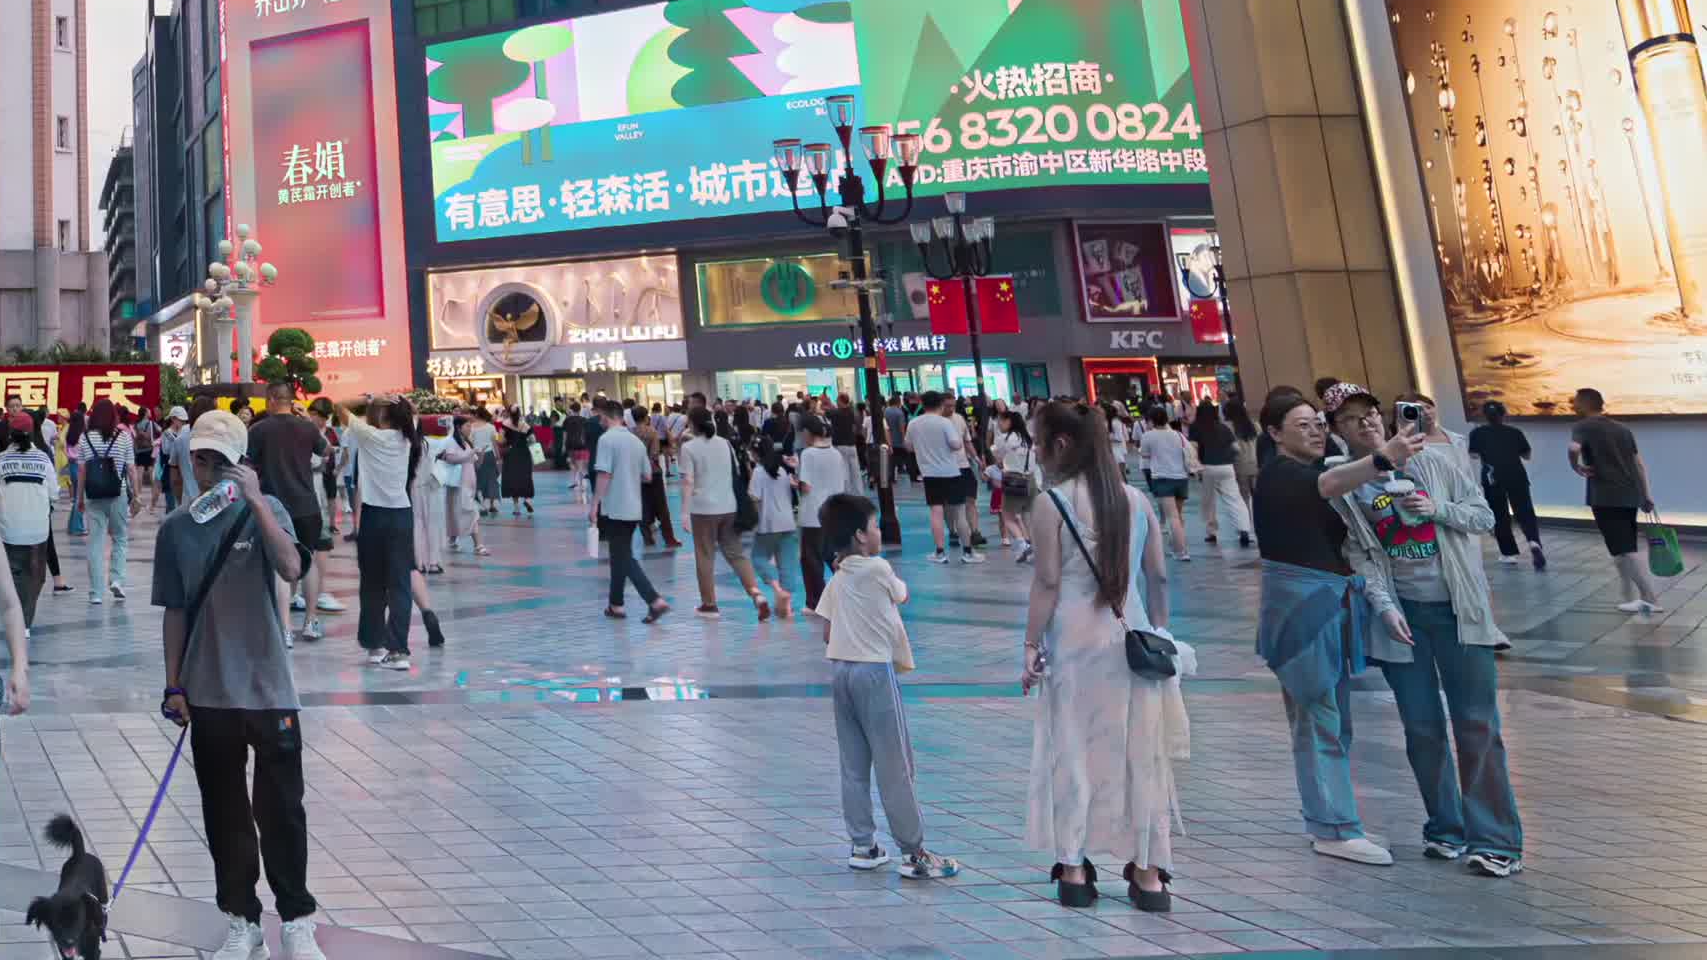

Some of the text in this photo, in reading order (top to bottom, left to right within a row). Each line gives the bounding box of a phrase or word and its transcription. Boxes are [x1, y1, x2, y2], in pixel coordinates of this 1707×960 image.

[958, 104, 1079, 150] 8320
[1086, 102, 1203, 141] 0824
[613, 130, 644, 142] VALLEY
[280, 139, 346, 187] 春娟
[1109, 330, 1164, 349] KFC
[794, 341, 831, 358] ABC
